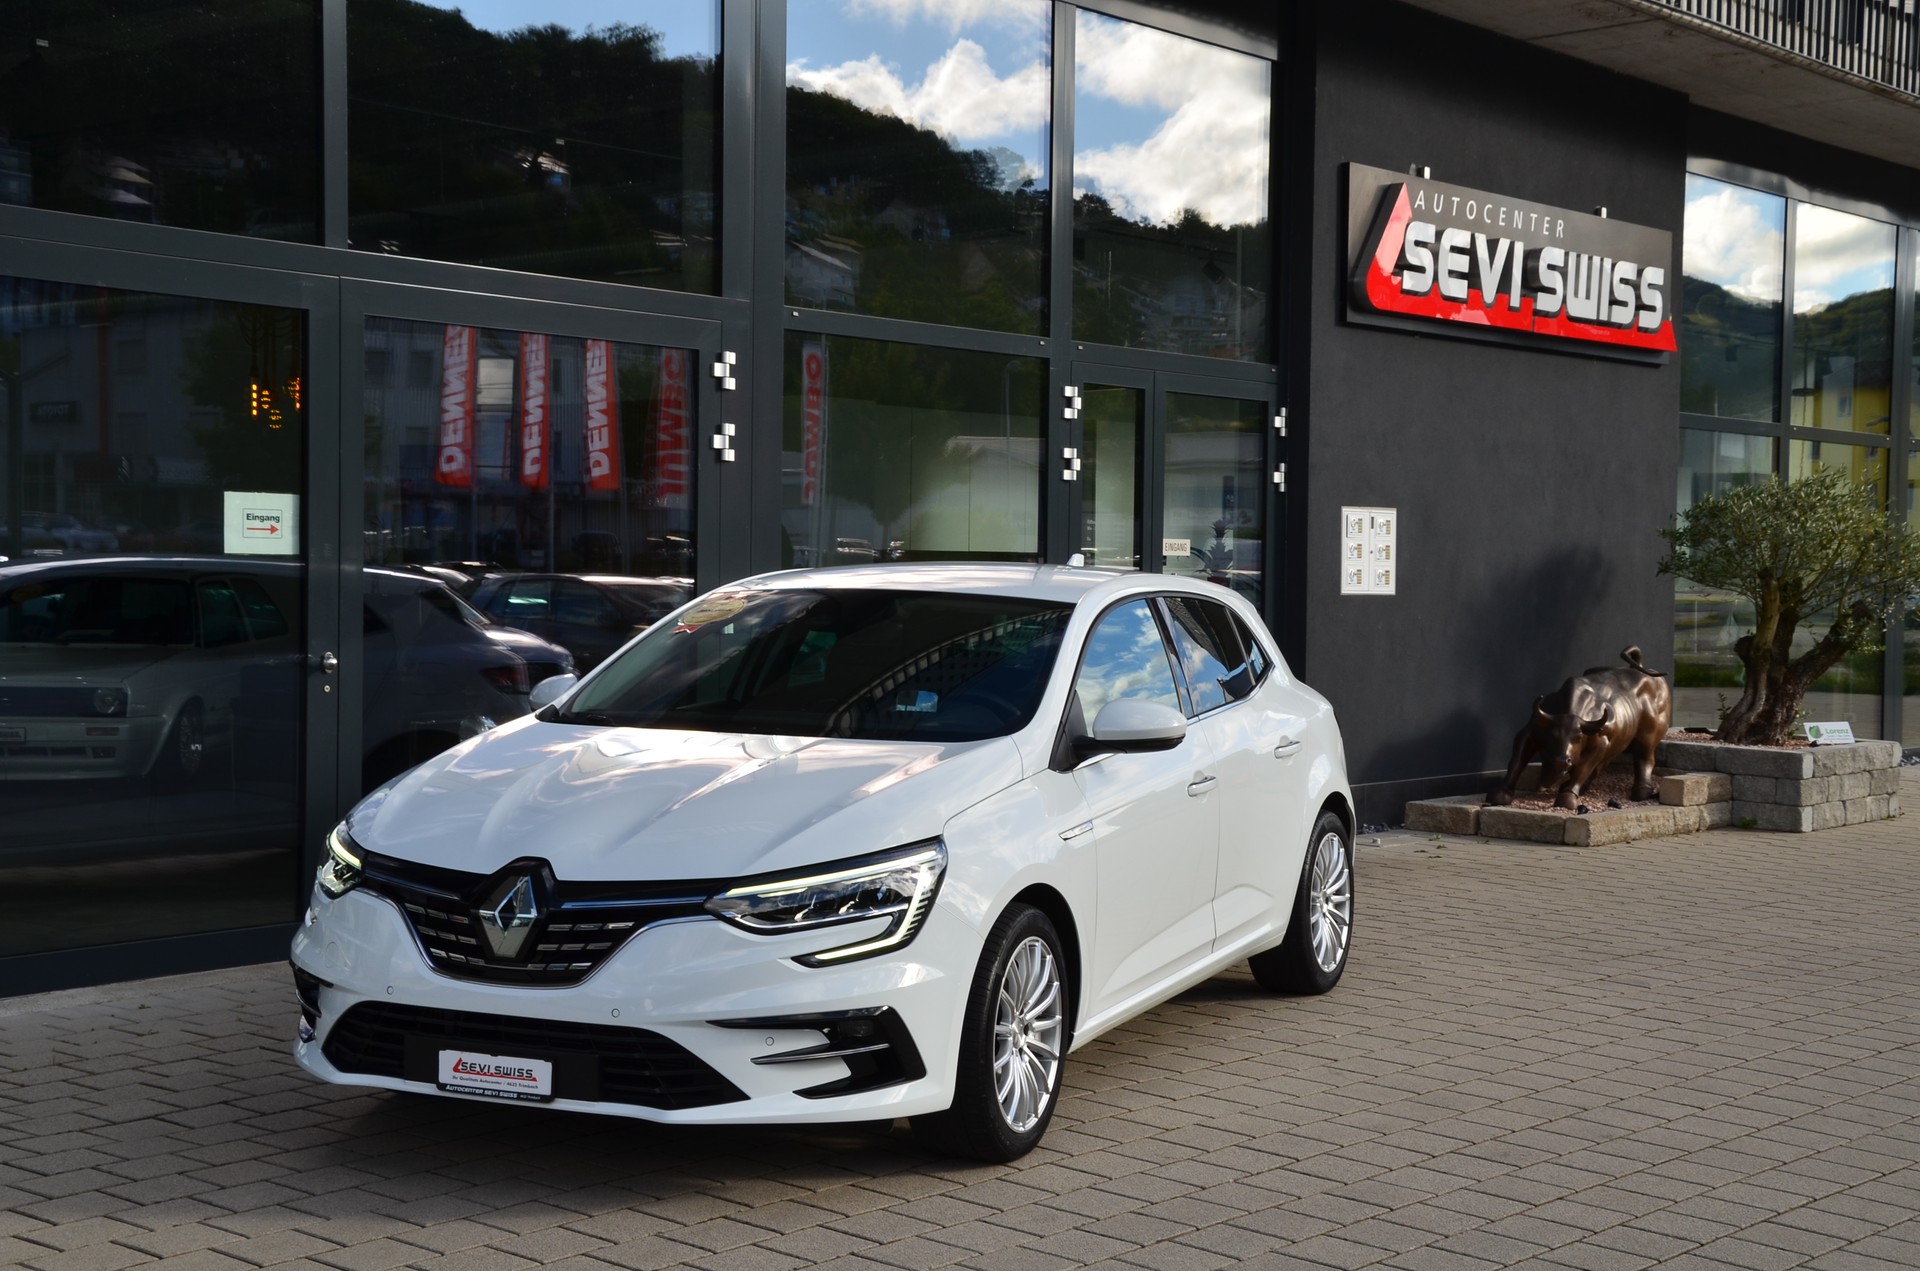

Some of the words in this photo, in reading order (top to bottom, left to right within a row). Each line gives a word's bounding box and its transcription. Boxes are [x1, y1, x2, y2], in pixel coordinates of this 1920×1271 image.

[1414, 190, 1564, 239] AUTOCENTER
[1401, 221, 1524, 309] SEVI
[1536, 246, 1665, 332] SWISS
[246, 513, 280, 523] Eingang
[1165, 543, 1188, 552] EINGANG
[460, 1061, 490, 1073] SEVI
[494, 1065, 533, 1078] SWISS
